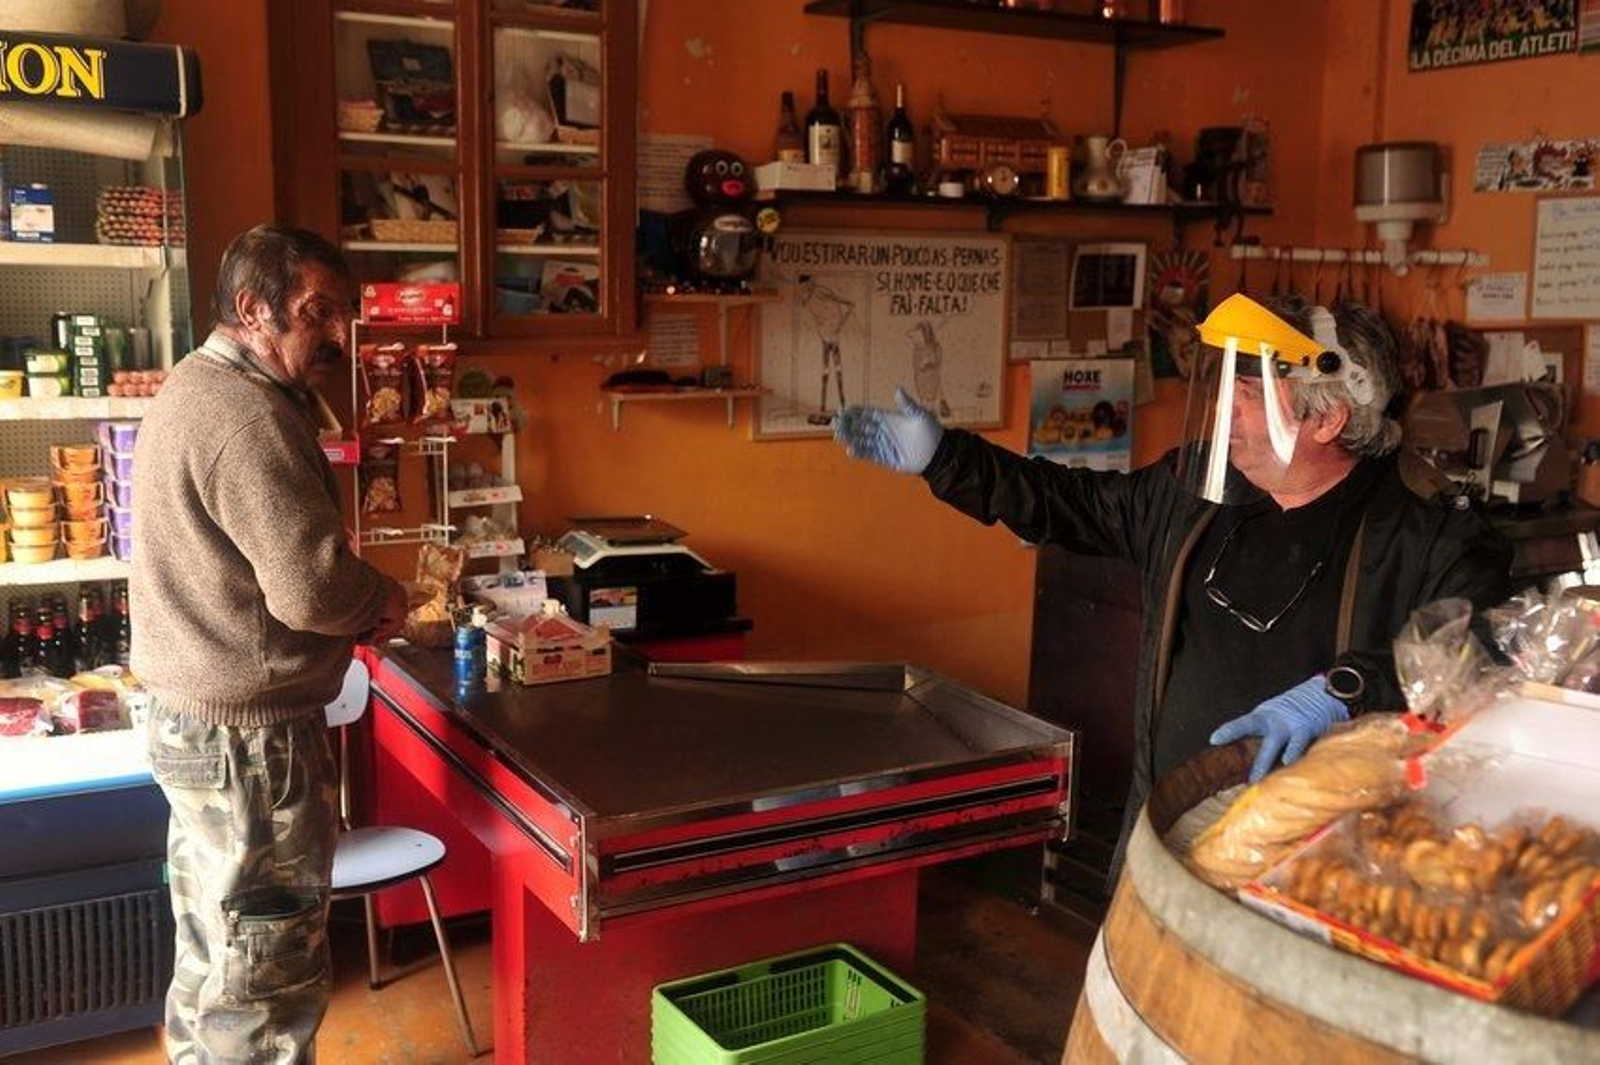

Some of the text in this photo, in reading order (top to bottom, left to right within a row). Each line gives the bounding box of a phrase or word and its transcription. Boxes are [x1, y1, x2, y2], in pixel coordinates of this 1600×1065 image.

[1488, 38, 1518, 60] DEL
[804, 241, 868, 266] ESTIRAR
[1063, 370, 1101, 384] HOXE
